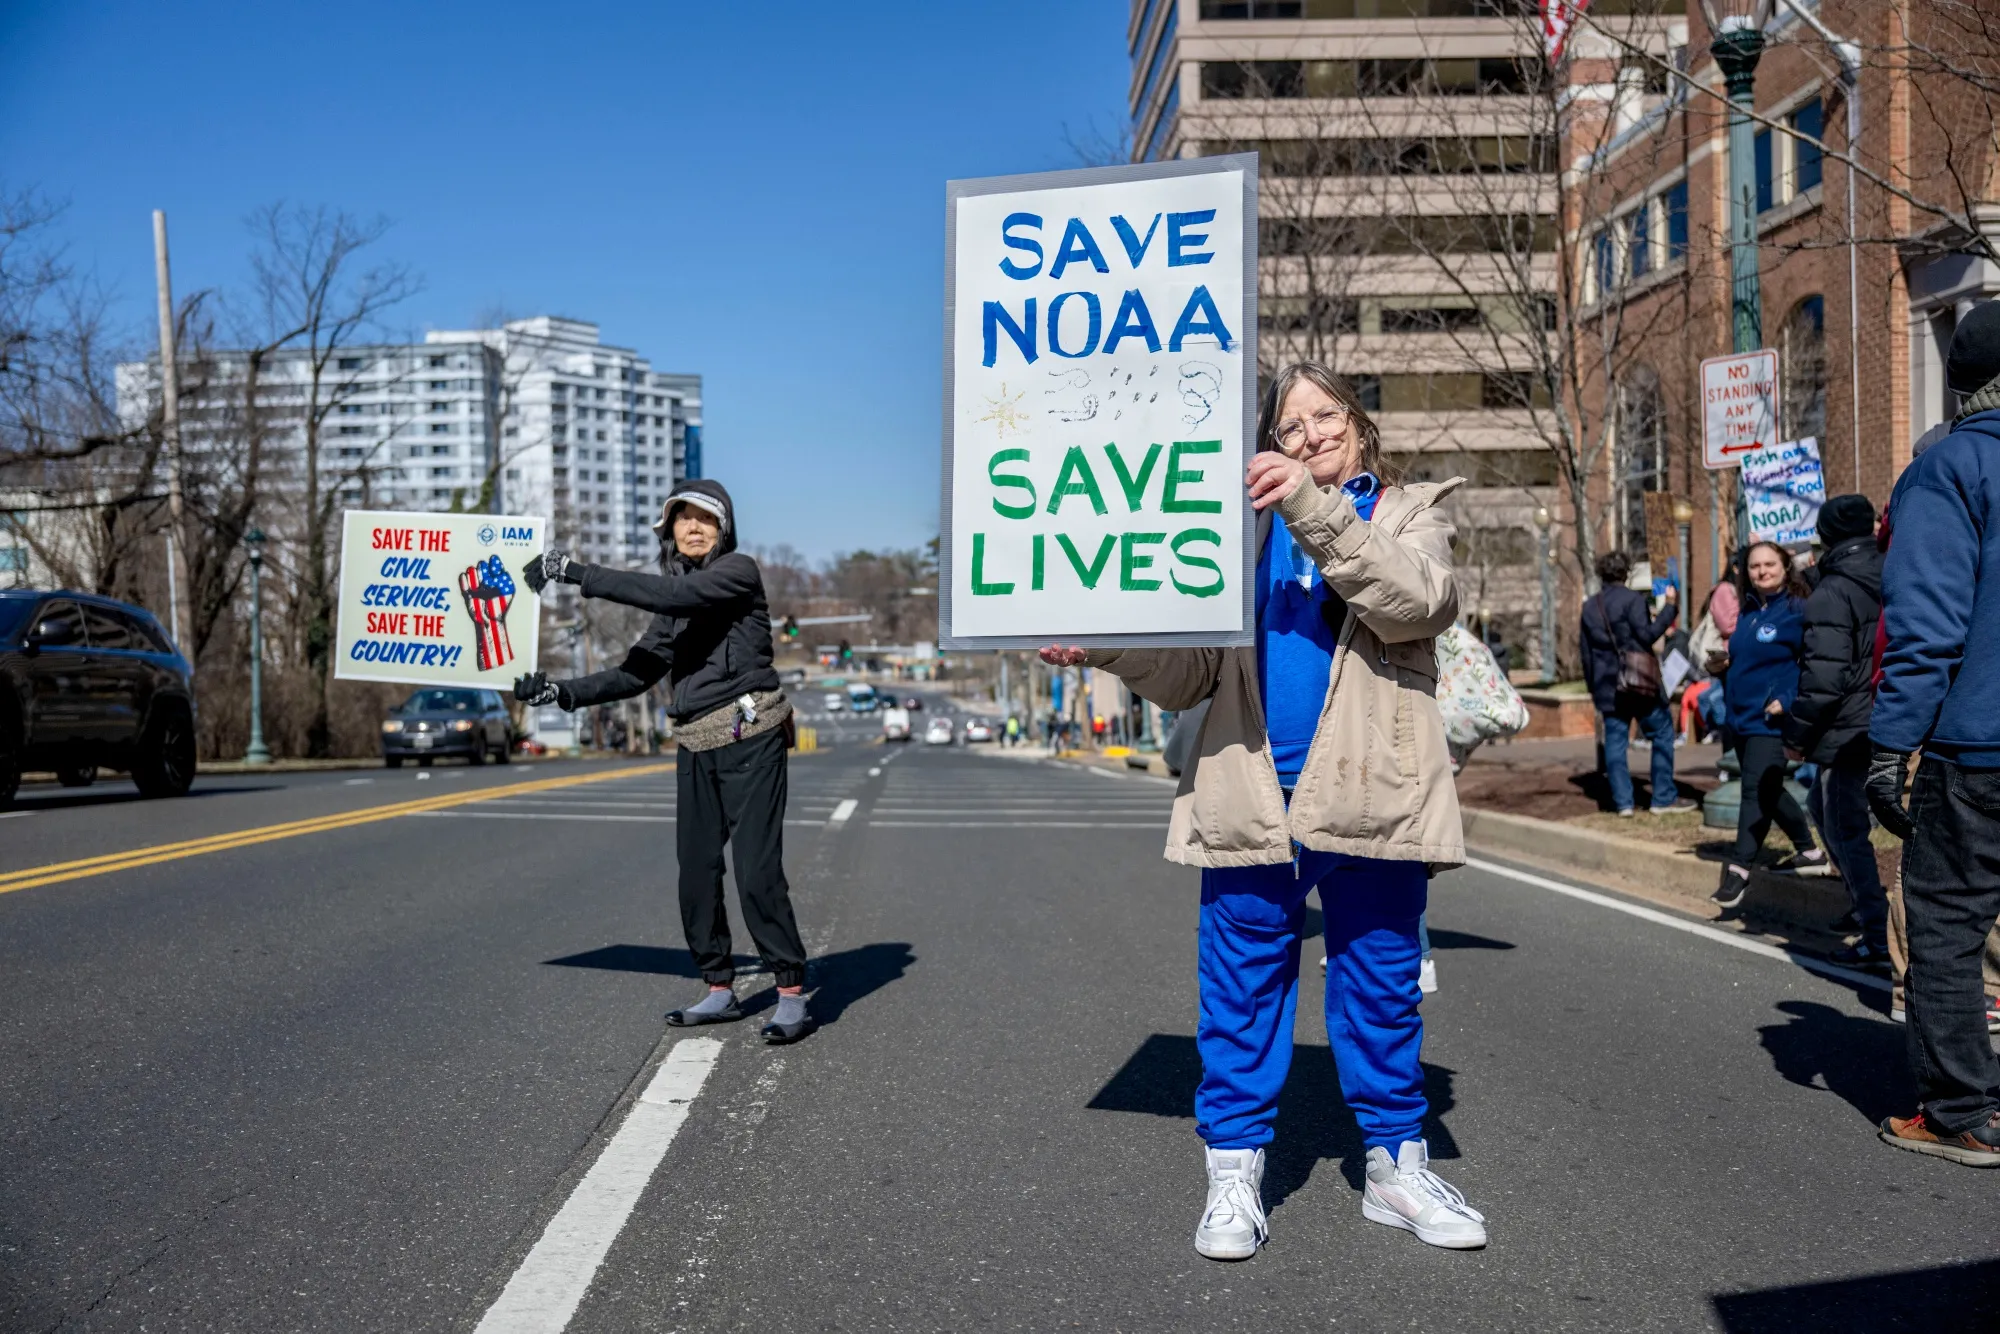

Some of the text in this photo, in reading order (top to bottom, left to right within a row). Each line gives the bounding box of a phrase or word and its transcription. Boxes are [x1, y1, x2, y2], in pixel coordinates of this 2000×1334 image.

[998, 209, 1217, 280] SAVE
[982, 284, 1236, 368] NOAA
[1727, 364, 1749, 380] NO
[1708, 379, 1772, 404] STANDING
[1725, 402, 1754, 418] ANY
[1725, 421, 1757, 437] TIME
[1743, 446, 1808, 468] Fish are
[1794, 458, 1821, 475] and
[988, 440, 1223, 520] SAVE
[1785, 474, 1823, 497] Food
[1752, 503, 1803, 529] NOAA
[372, 528, 451, 552] SAVE THE
[502, 527, 533, 540] IAM
[380, 556, 431, 580] CIVIL
[971, 527, 1226, 598] LIVES
[360, 584, 451, 612] SERVICE,
[366, 612, 445, 637] SAVE THE
[350, 639, 463, 667] COUNTRY!
